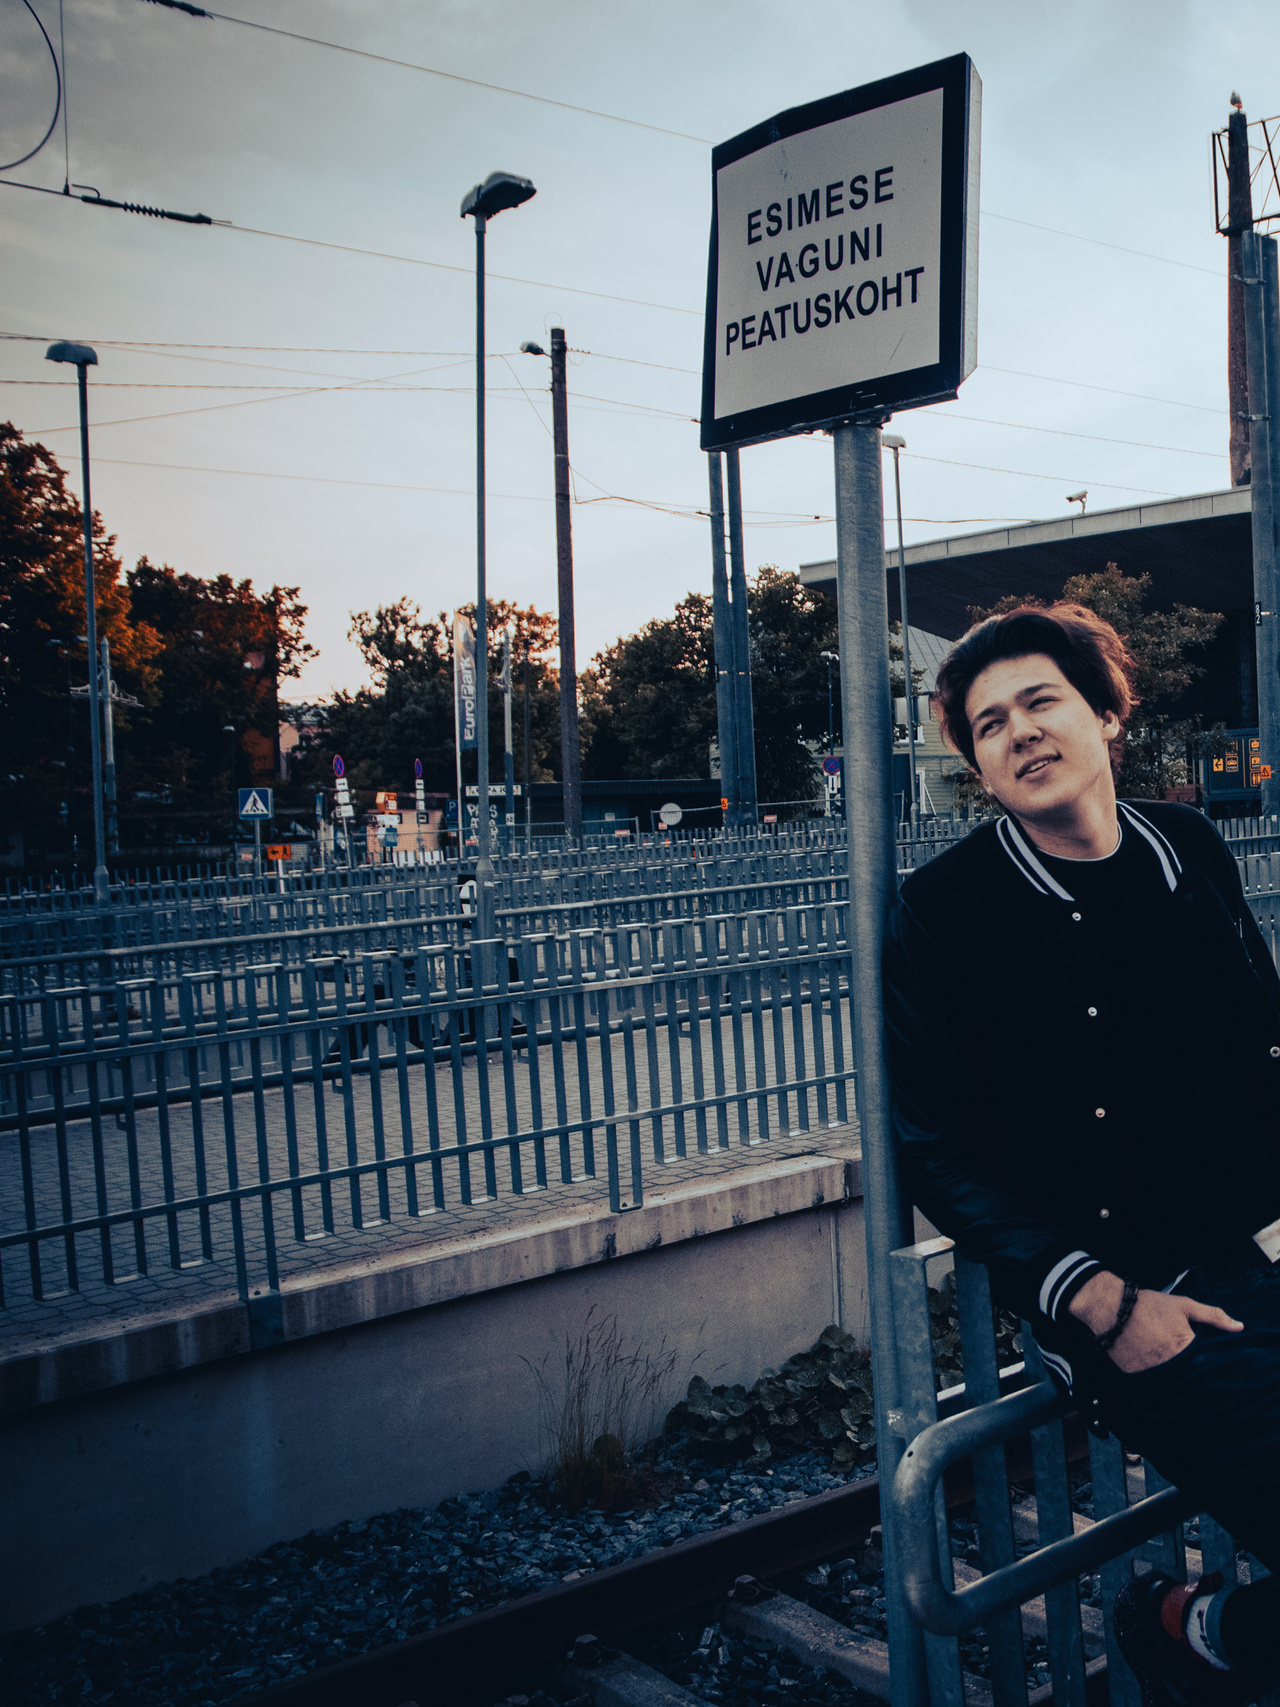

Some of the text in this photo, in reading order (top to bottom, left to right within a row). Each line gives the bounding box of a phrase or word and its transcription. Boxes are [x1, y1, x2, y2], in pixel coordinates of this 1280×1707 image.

[747, 165, 894, 245] ESIMESE
[755, 223, 883, 293] VAGUNI
[726, 266, 925, 356] PEATUSKOHT
[1255, 603, 1262, 625] 82
[459, 655, 476, 741] EuroPark
